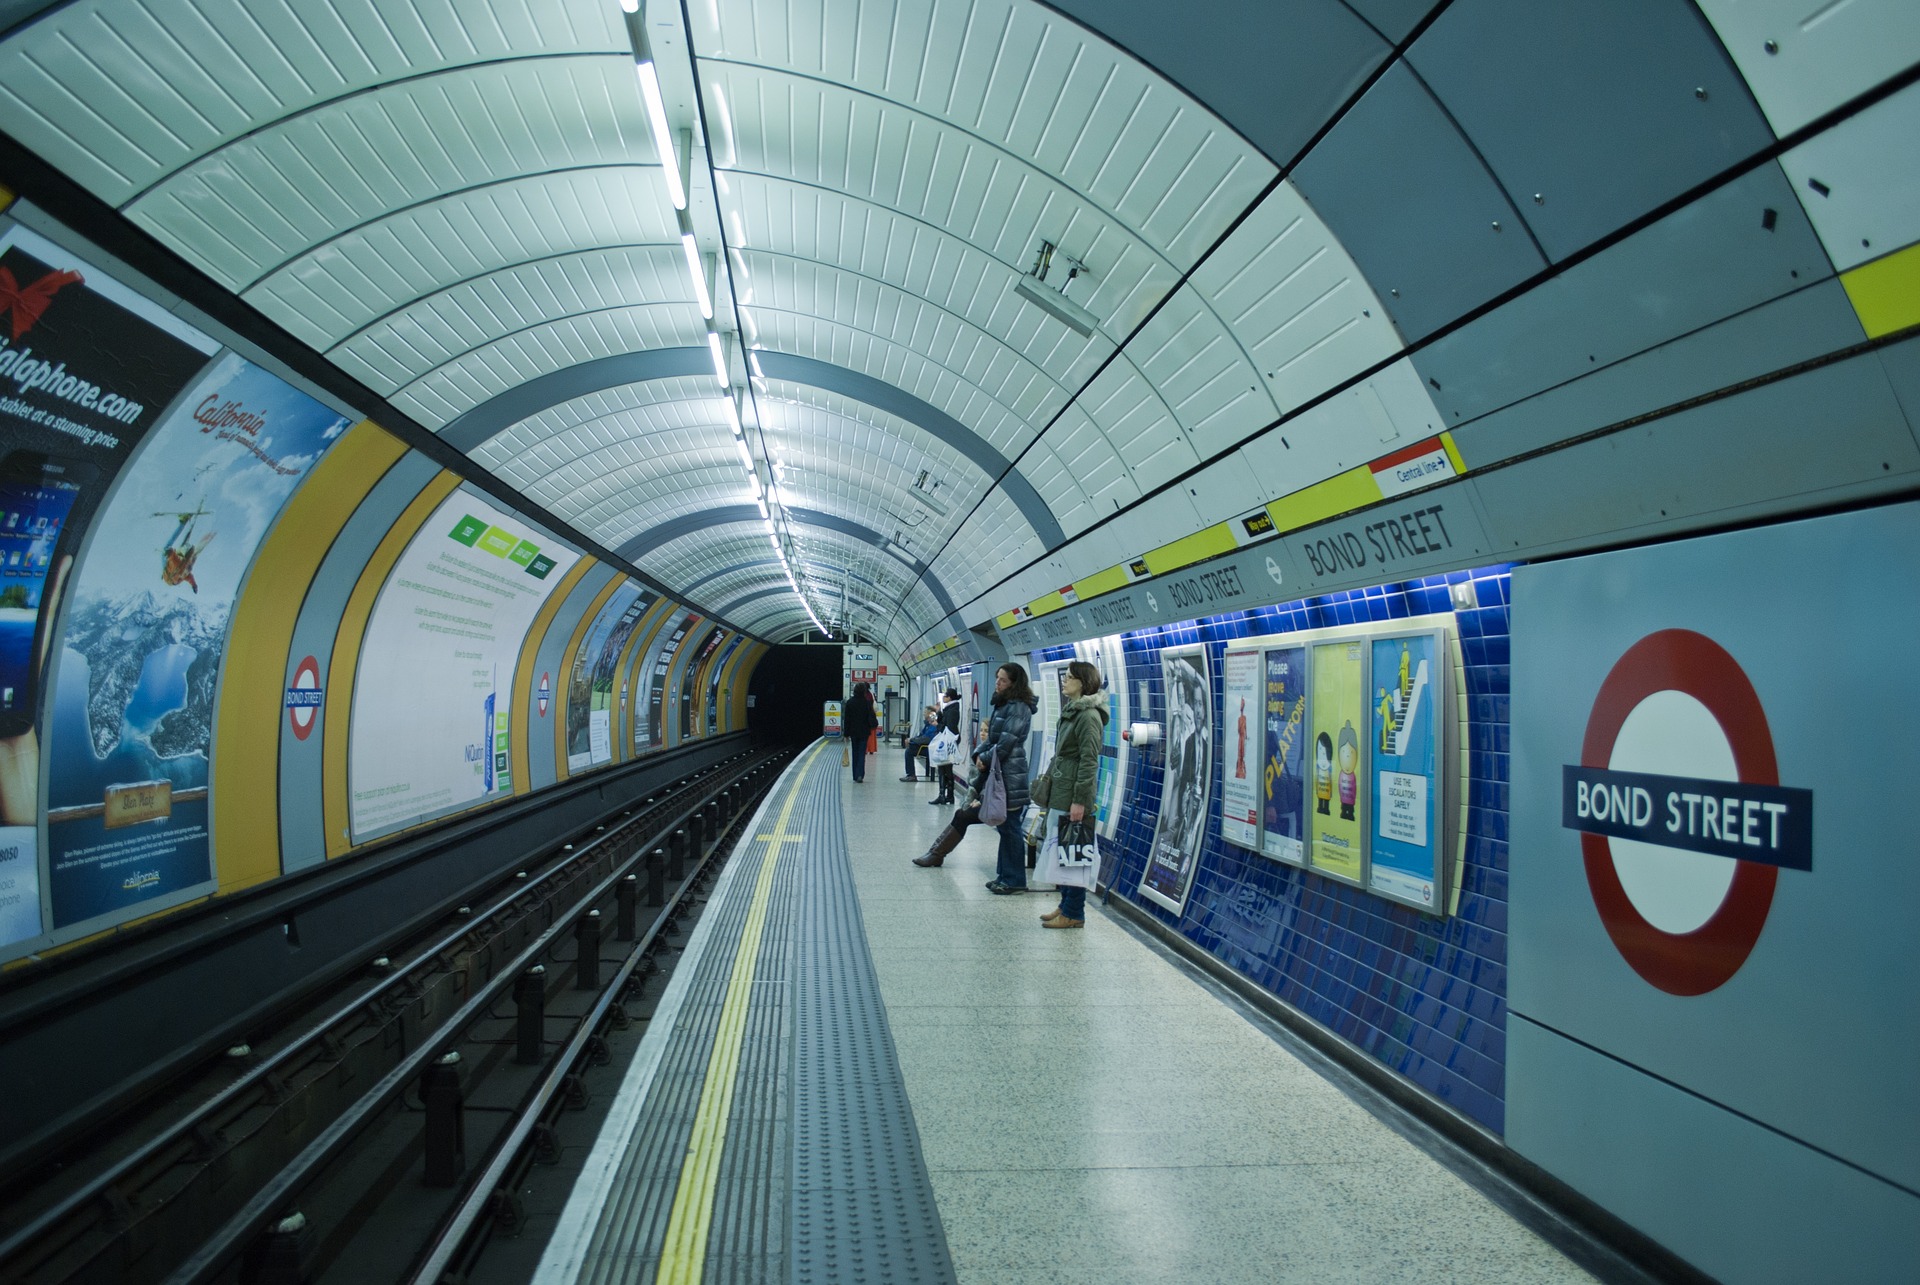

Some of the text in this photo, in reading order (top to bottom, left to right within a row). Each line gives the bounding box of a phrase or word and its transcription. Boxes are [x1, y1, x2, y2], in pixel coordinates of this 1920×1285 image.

[0, 335, 143, 424] alaphone.com
[0, 396, 119, 448] tablet at a stunning price
[193, 394, 267, 437] California
[1397, 461, 1439, 482] Central line
[1303, 504, 1453, 577] BOND STREET
[1168, 565, 1246, 609] BOND STREET
[1089, 596, 1137, 627] BOND STREET
[1267, 660, 1288, 675] Please
[287, 691, 322, 704] BOND STREET
[1267, 682, 1285, 694] move
[1267, 716, 1278, 731] the
[1265, 695, 1305, 801] PLATFORM
[1393, 776, 1411, 787] USE THE
[1388, 787, 1416, 800] ESCALATORS
[1394, 799, 1410, 810] SAFELY
[1577, 780, 1788, 849] BOND STREET
[124, 869, 160, 888] california
